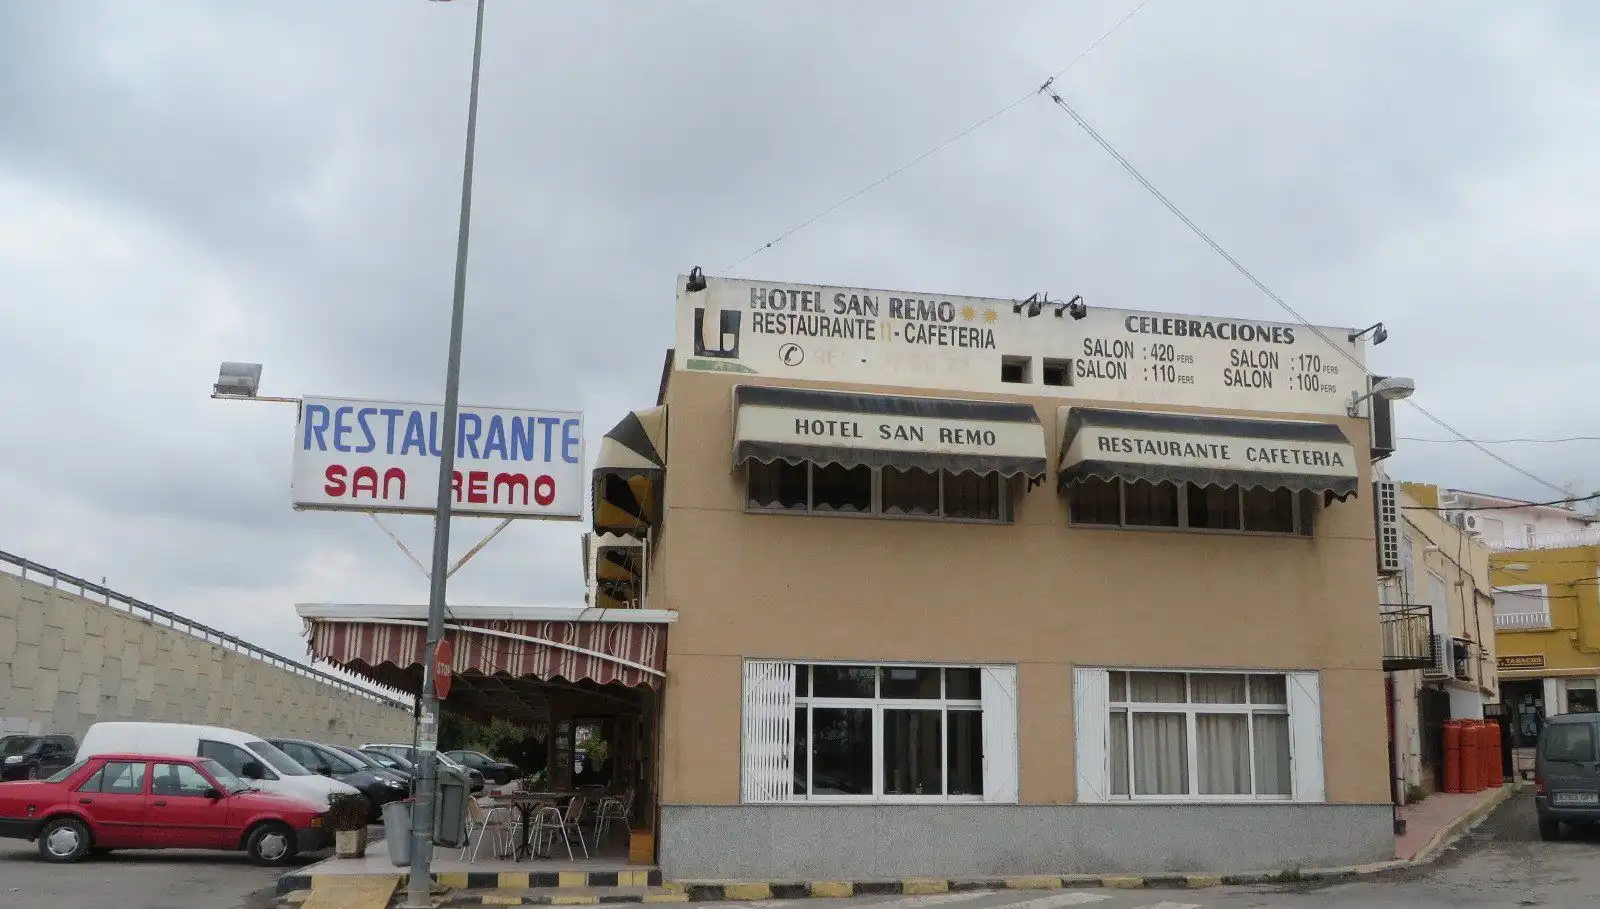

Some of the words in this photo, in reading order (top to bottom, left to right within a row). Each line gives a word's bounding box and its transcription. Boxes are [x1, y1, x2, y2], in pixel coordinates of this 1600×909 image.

[750, 287, 826, 313] HOTEL
[833, 292, 879, 318] SAN
[888, 297, 956, 323] REMO
[752, 311, 876, 340] RESTAURANTE
[904, 322, 996, 350] CAFETERIA
[1124, 315, 1295, 344] CELEBRACIONES
[1083, 337, 1134, 359] SALON
[1176, 355, 1194, 364] PERS
[1230, 348, 1279, 369] SALON
[1322, 365, 1339, 374] PERS
[1076, 359, 1127, 380] SALON
[1177, 375, 1195, 384] PERS
[1223, 368, 1273, 388] SALON
[1320, 384, 1337, 393] PERS
[303, 404, 579, 463] RESTAURANTE
[795, 418, 863, 438] HOTEL
[878, 424, 924, 442] SAN
[939, 427, 996, 446] REMO
[1097, 436, 1231, 460] RESTAURANTE
[1246, 446, 1344, 467] CAFETERIA
[324, 464, 406, 500] SAN
[437, 662, 451, 676] STOP
